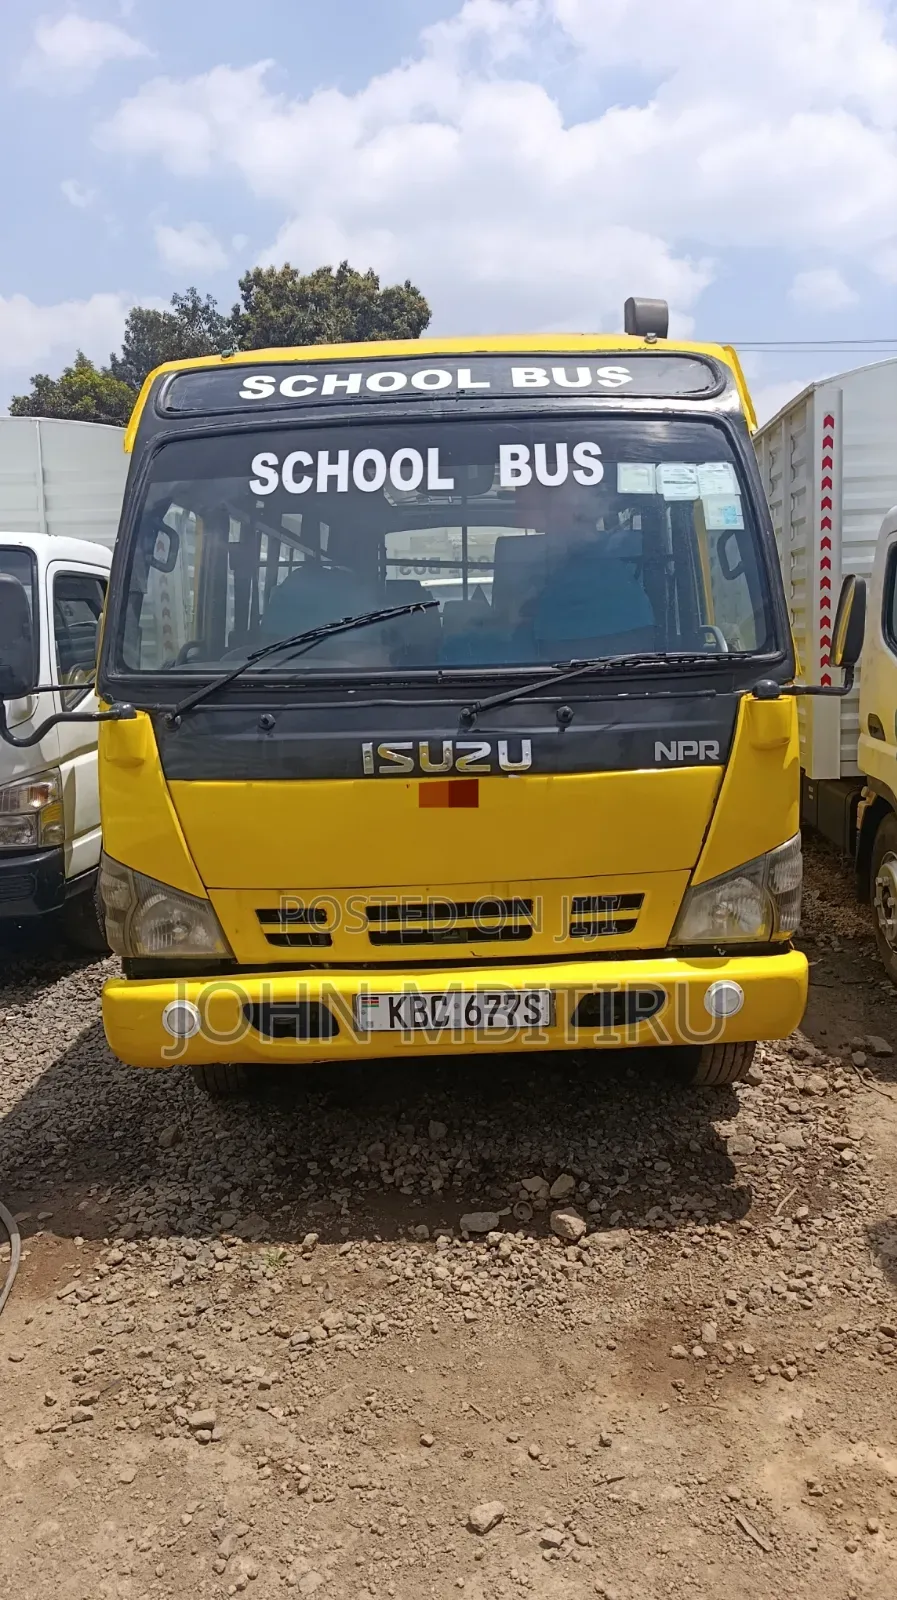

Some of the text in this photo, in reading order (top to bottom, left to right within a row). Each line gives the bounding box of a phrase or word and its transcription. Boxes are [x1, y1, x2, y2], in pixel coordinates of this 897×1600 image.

[239, 366, 633, 399] SCHOOL BUS
[249, 442, 604, 495] SCHOOL BUS
[362, 739, 532, 774] ISUZU
[654, 740, 720, 761] NPR
[388, 993, 541, 1029] KBC 677S
